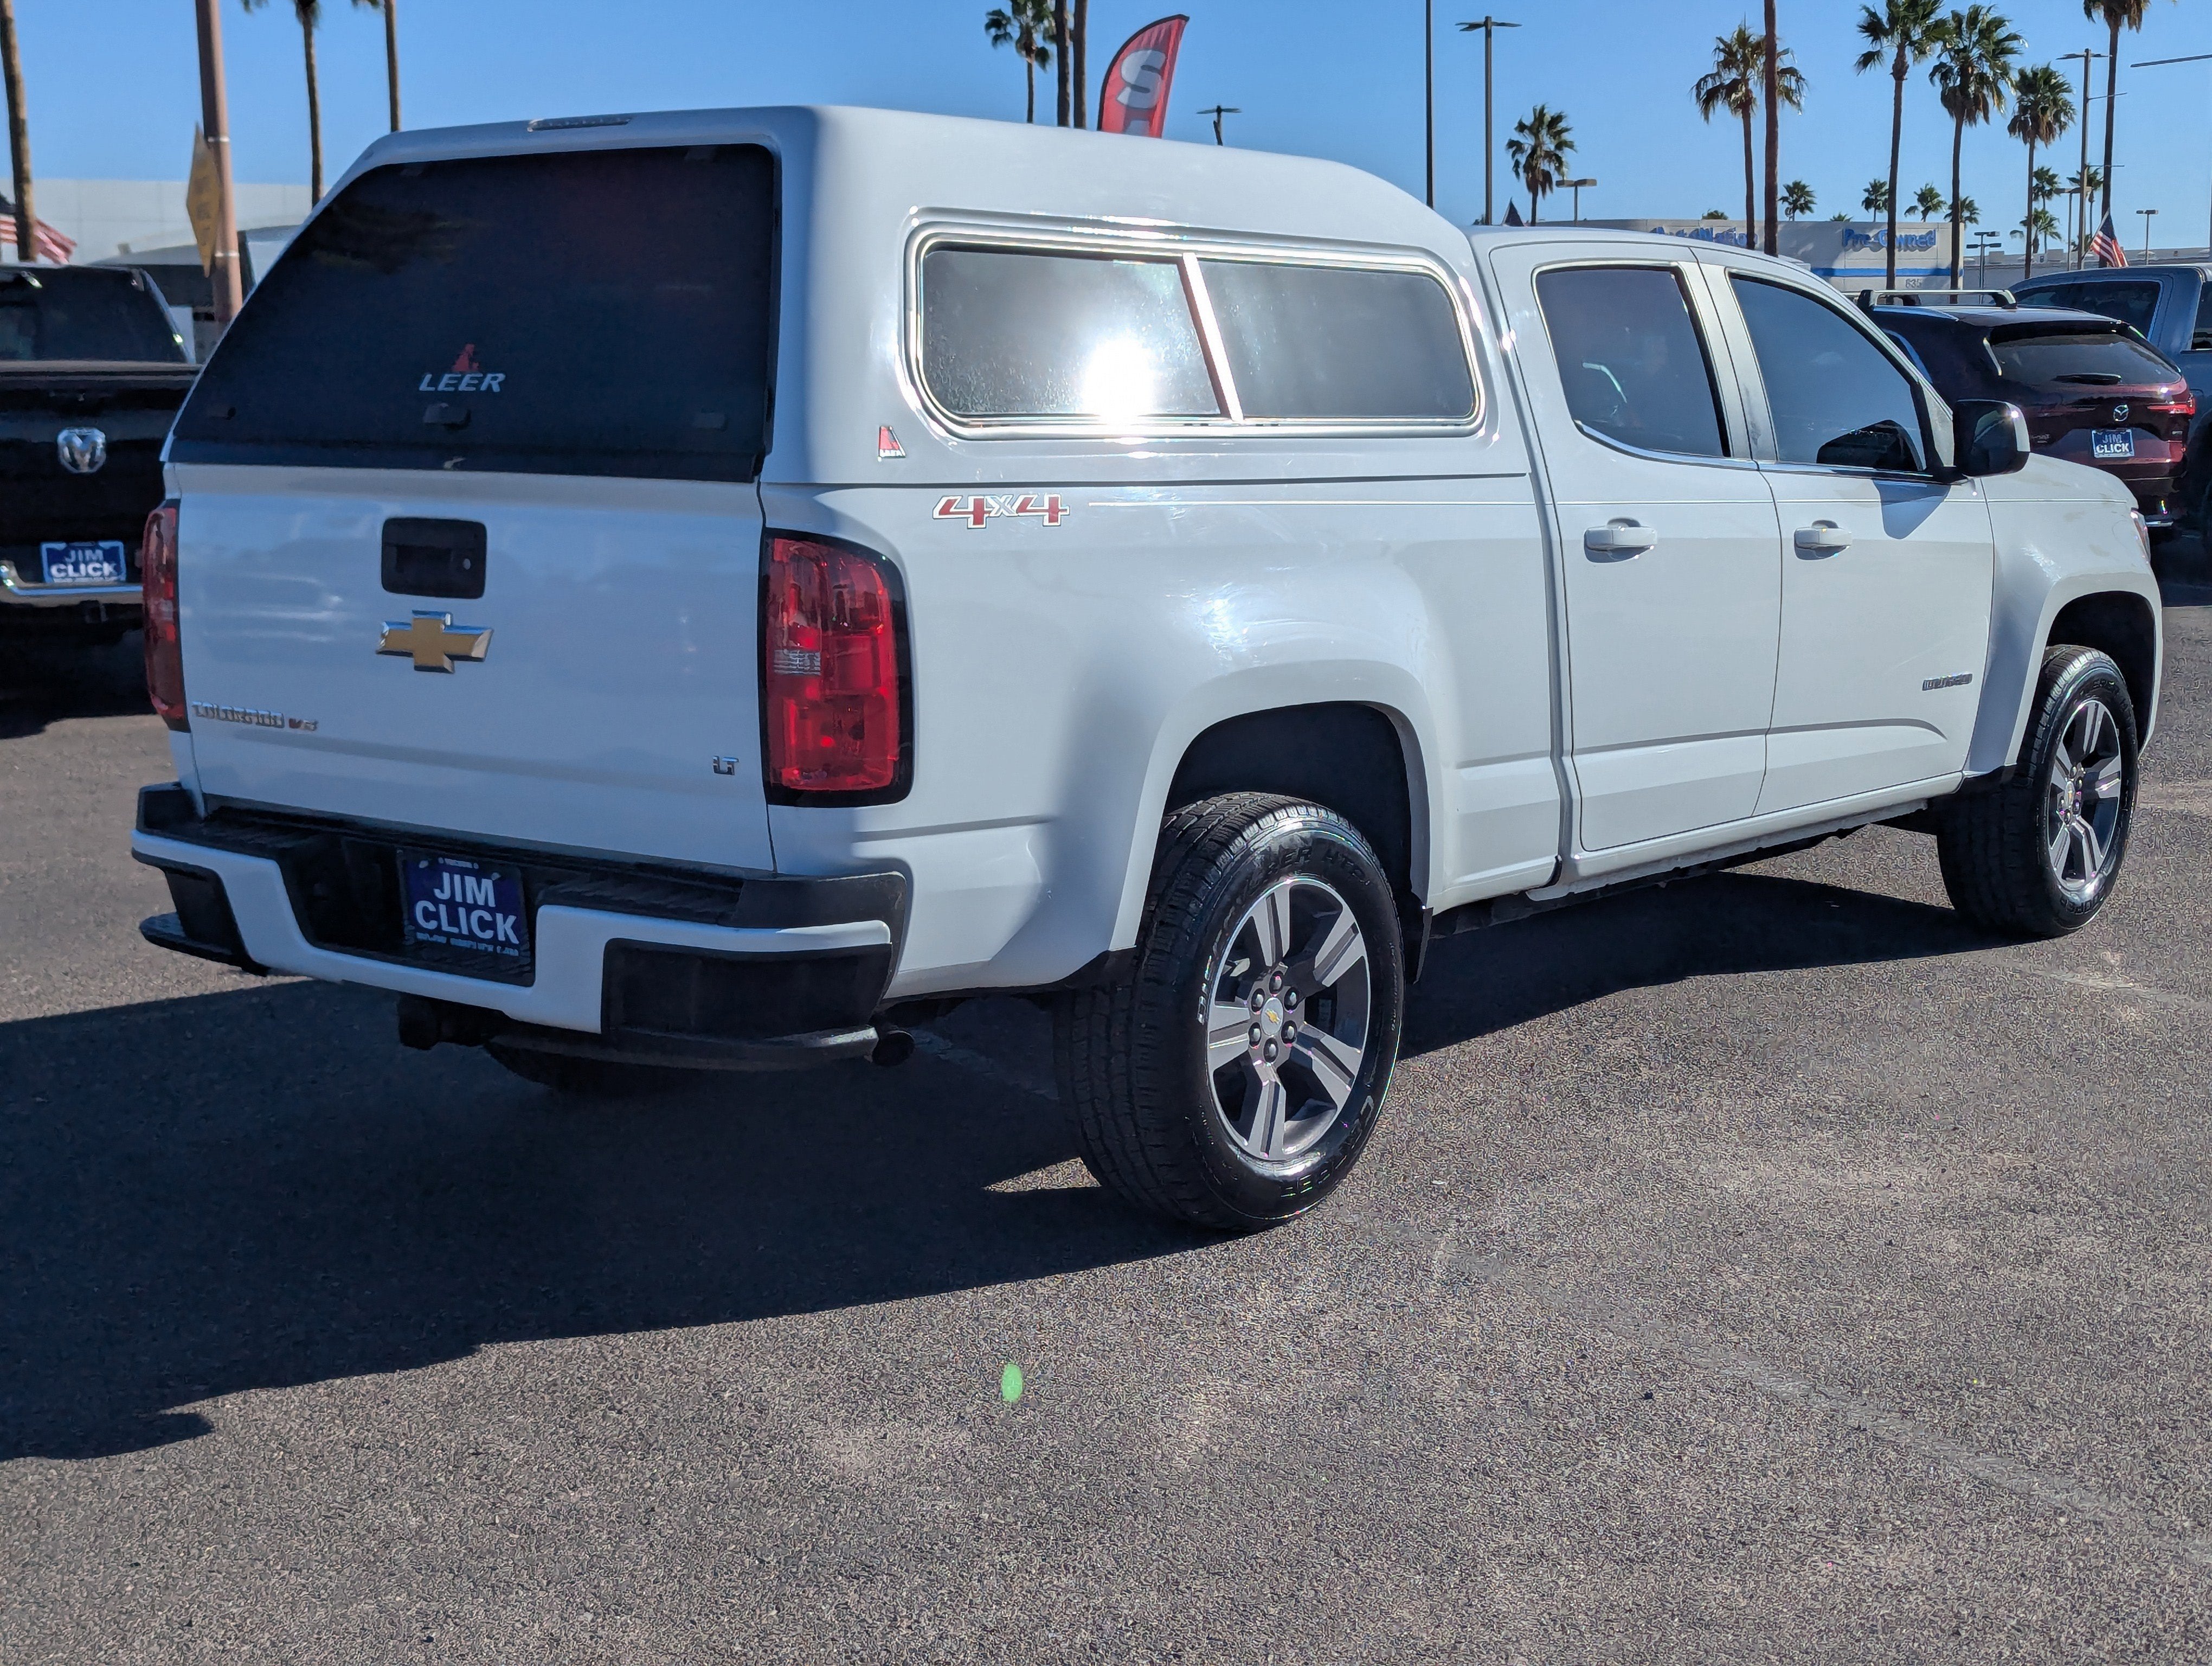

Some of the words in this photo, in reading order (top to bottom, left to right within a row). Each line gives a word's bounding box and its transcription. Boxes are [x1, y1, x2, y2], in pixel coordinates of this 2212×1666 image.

[419, 373, 506, 392] LEER
[2102, 434, 2123, 443] JIM
[2096, 443, 2130, 453] CLICK
[65, 549, 104, 563] JIM
[50, 561, 118, 578] CLICK
[712, 755, 739, 776] LT
[434, 872, 496, 907] JIM
[416, 900, 519, 944] CLICK
